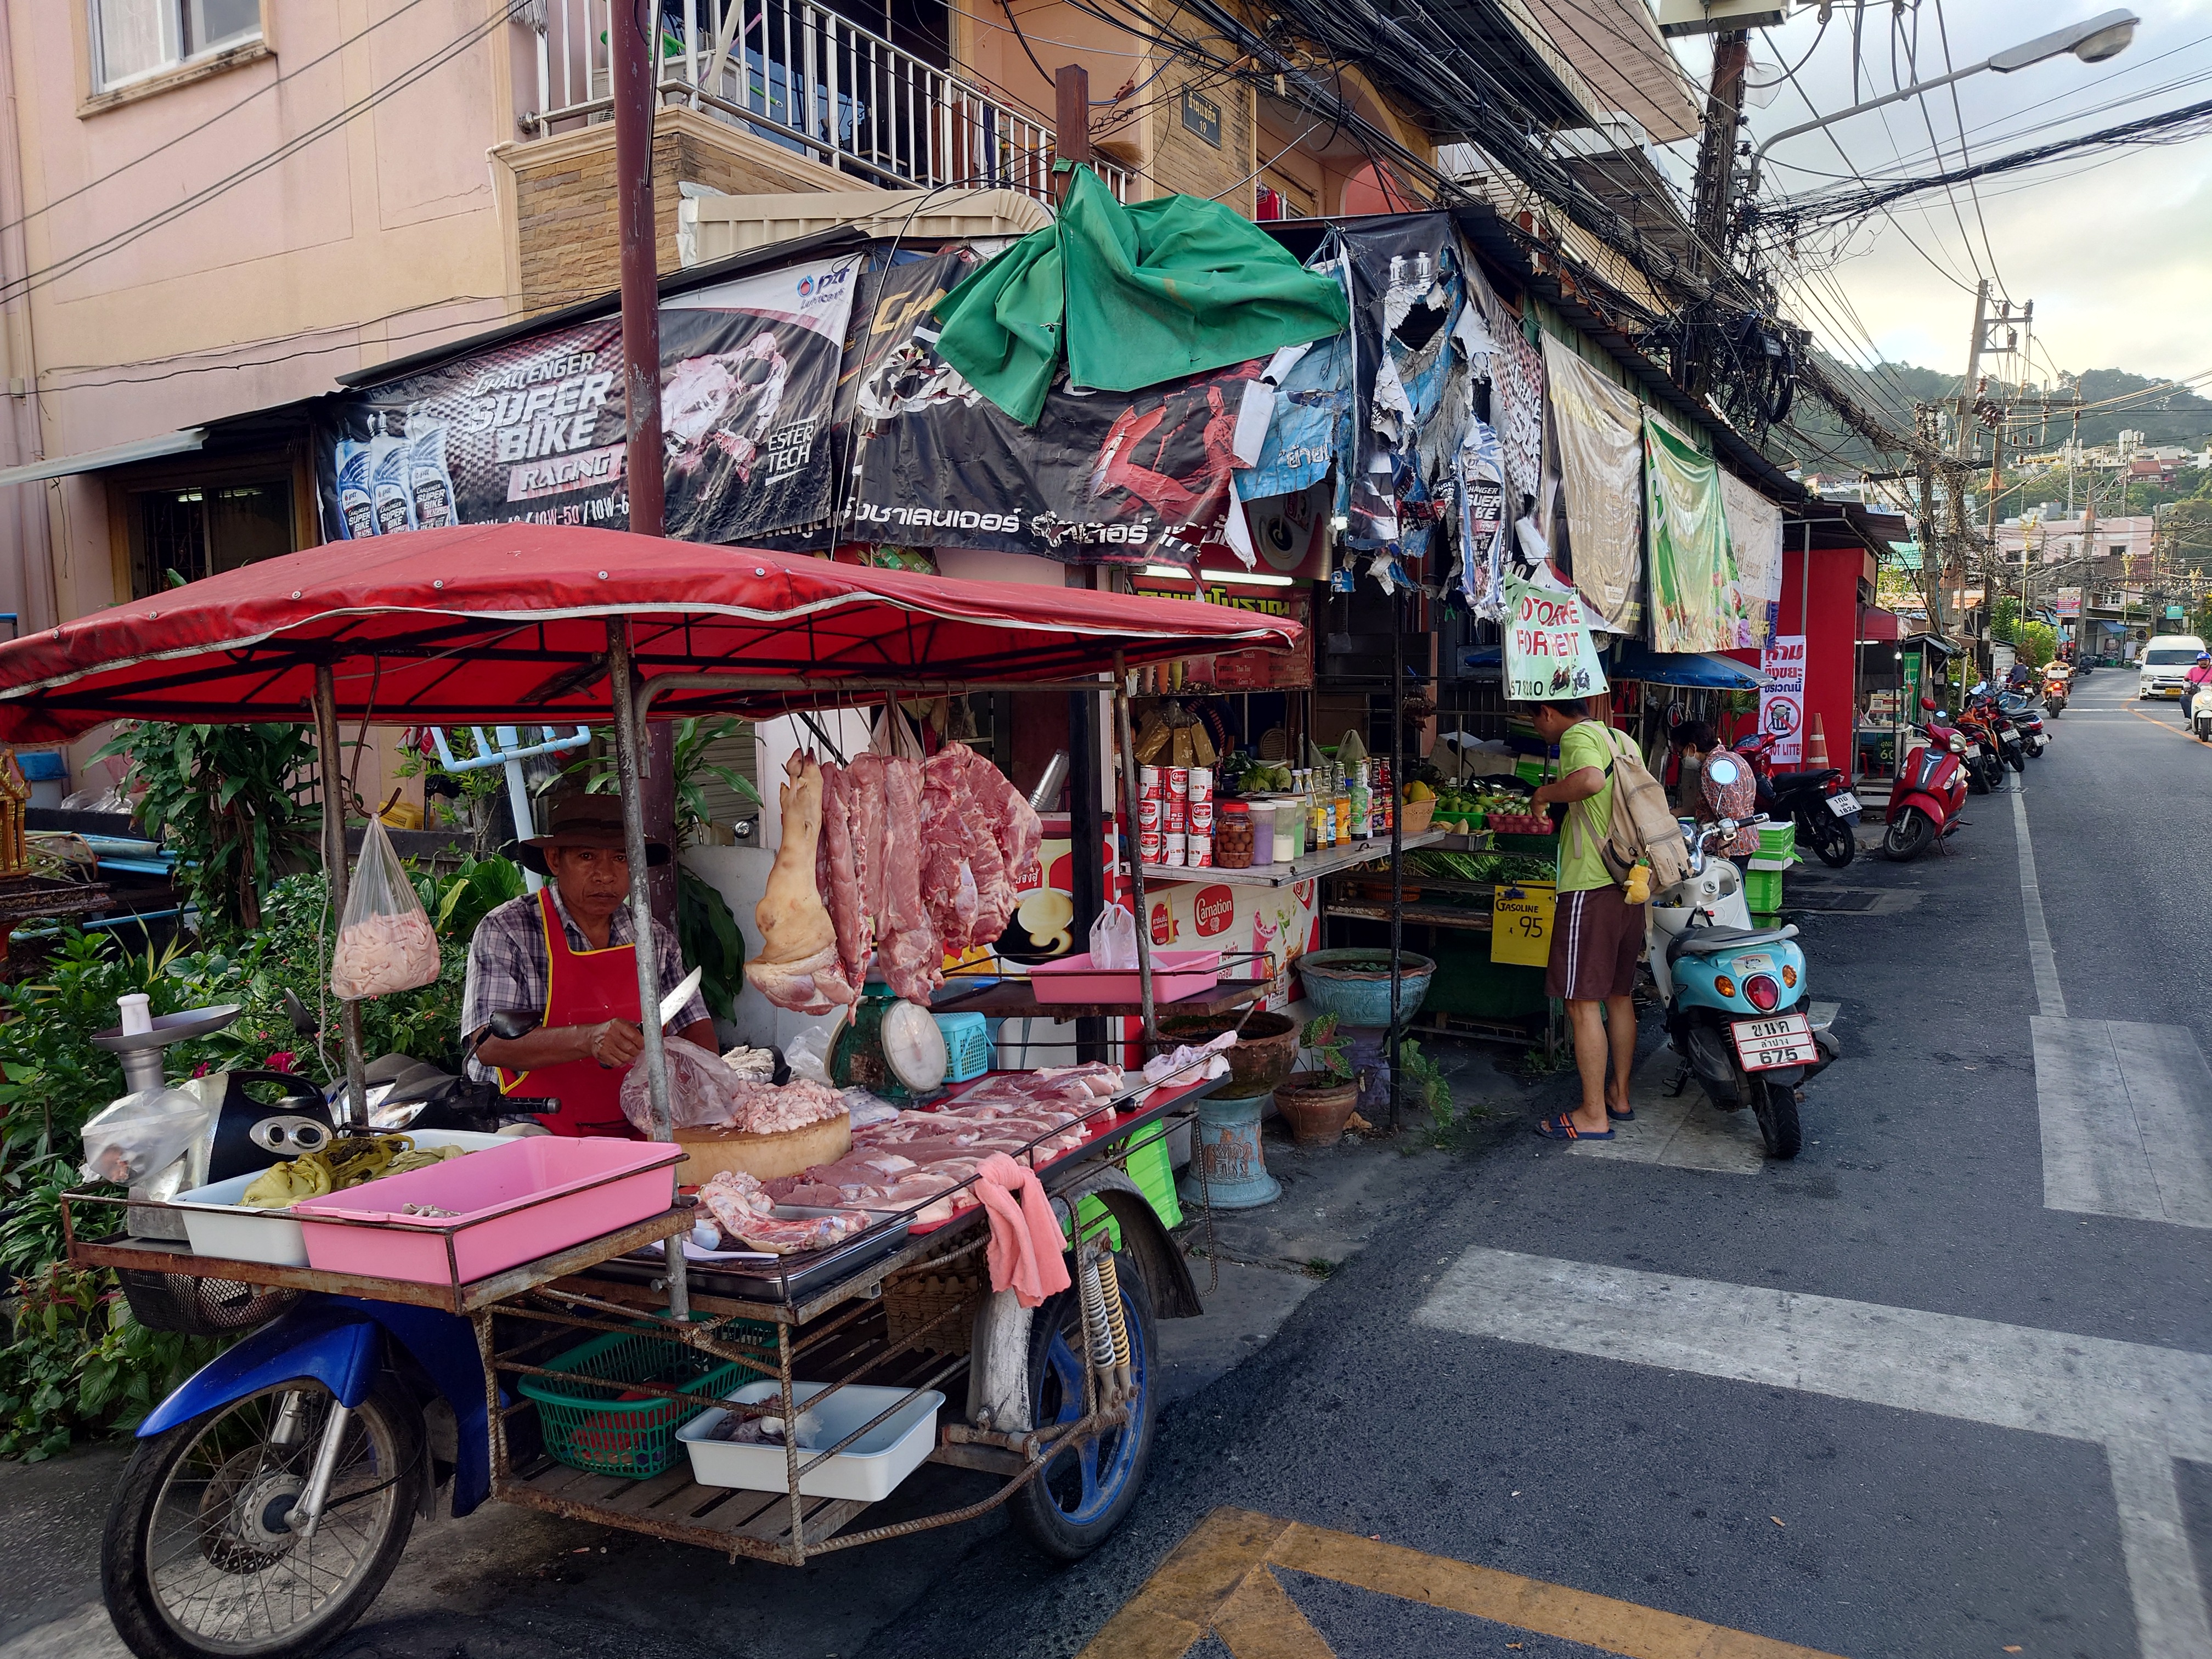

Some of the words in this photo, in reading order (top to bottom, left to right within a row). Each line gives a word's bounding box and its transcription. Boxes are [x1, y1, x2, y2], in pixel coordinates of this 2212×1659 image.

[1199, 120, 1207, 134] 19
[472, 351, 596, 397] CHALLENGER
[469, 371, 614, 434] SUPER
[494, 410, 599, 463] BIKE
[769, 425, 814, 452] ESTER
[769, 444, 811, 473] TECH
[521, 452, 611, 492] RACING
[416, 489, 445, 504] SUPER
[424, 498, 444, 510] BIKE
[380, 507, 405, 523] SUPER
[591, 493, 629, 521] 10W-6
[348, 511, 371, 526] SUPER
[354, 520, 370, 532] BIKE
[387, 516, 404, 529] BIKE
[1516, 629, 1548, 656] FOR
[1765, 642, 1803, 661] ห้าม
[1765, 661, 1803, 678] ทิ้งขยะ
[1764, 678, 1802, 693] บรเวณนี้
[1839, 804, 1857, 814] 1824
[1196, 898, 1233, 927] Carnation
[1496, 898, 1539, 913] GASOLINE
[1519, 916, 1543, 938] 95
[1760, 1037, 1789, 1048] ลำปาง
[1759, 1048, 1798, 1064] 675
